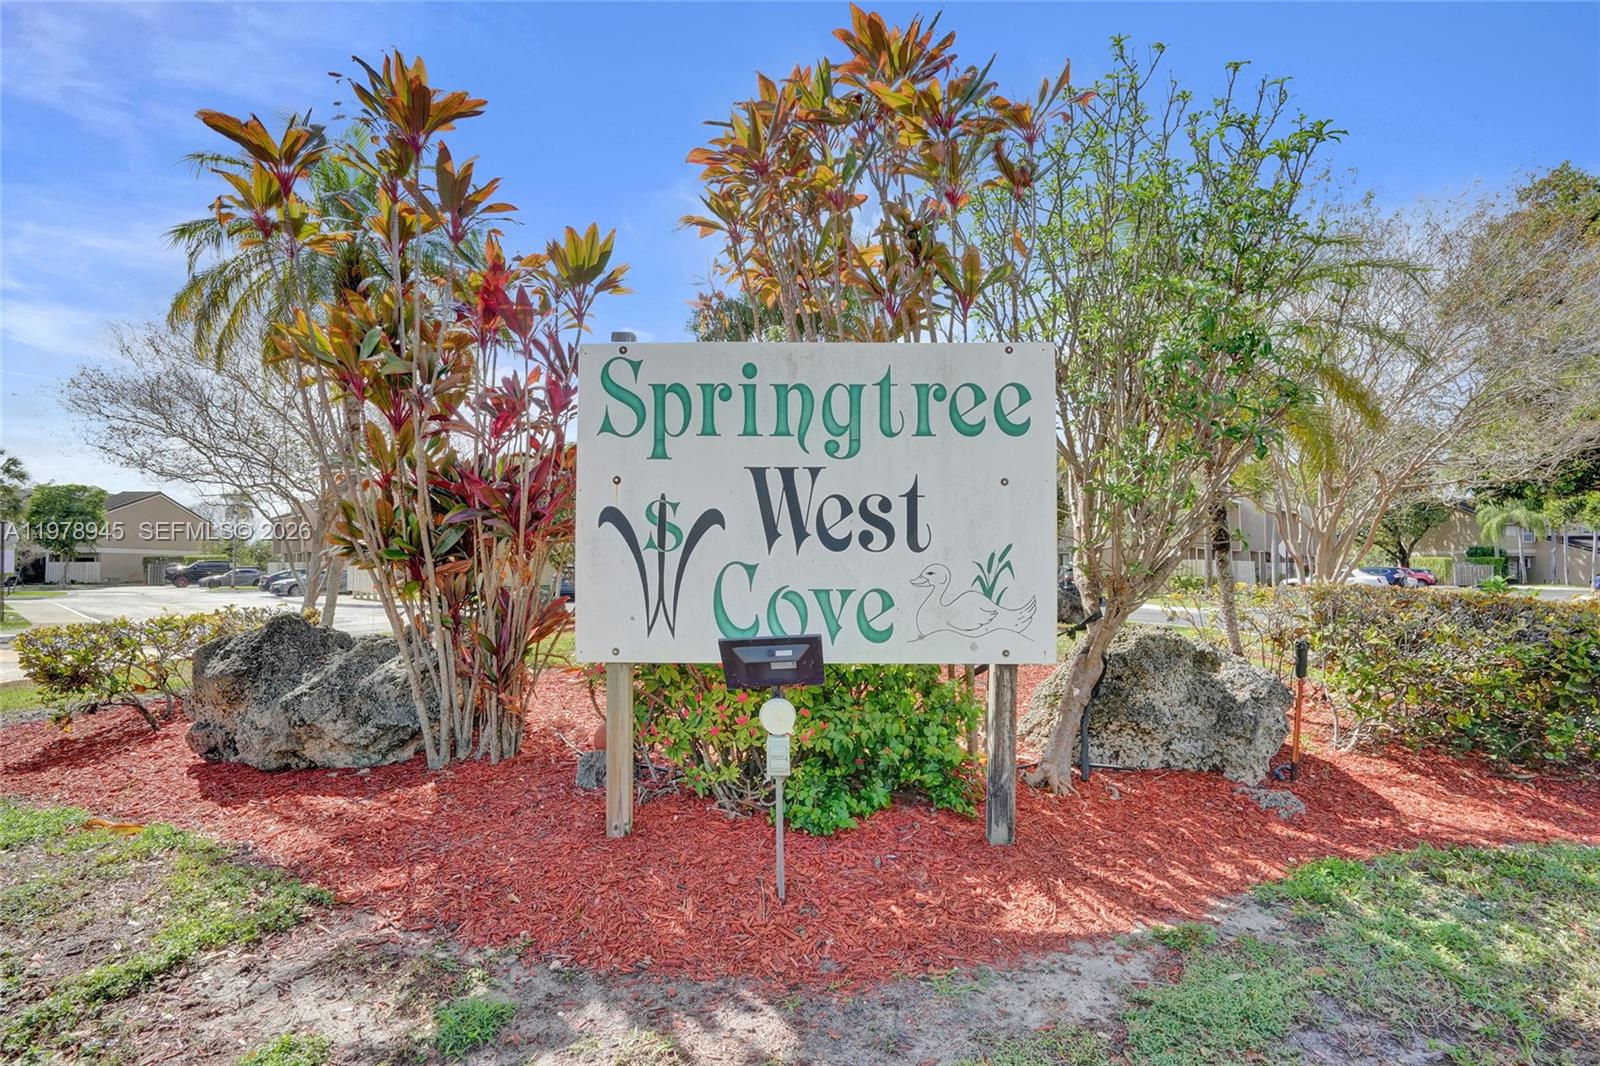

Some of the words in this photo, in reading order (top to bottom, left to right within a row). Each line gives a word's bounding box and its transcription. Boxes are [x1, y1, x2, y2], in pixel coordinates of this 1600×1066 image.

[596, 356, 1032, 460] Springtree
[743, 466, 932, 556] West
[713, 561, 896, 647] Cove
